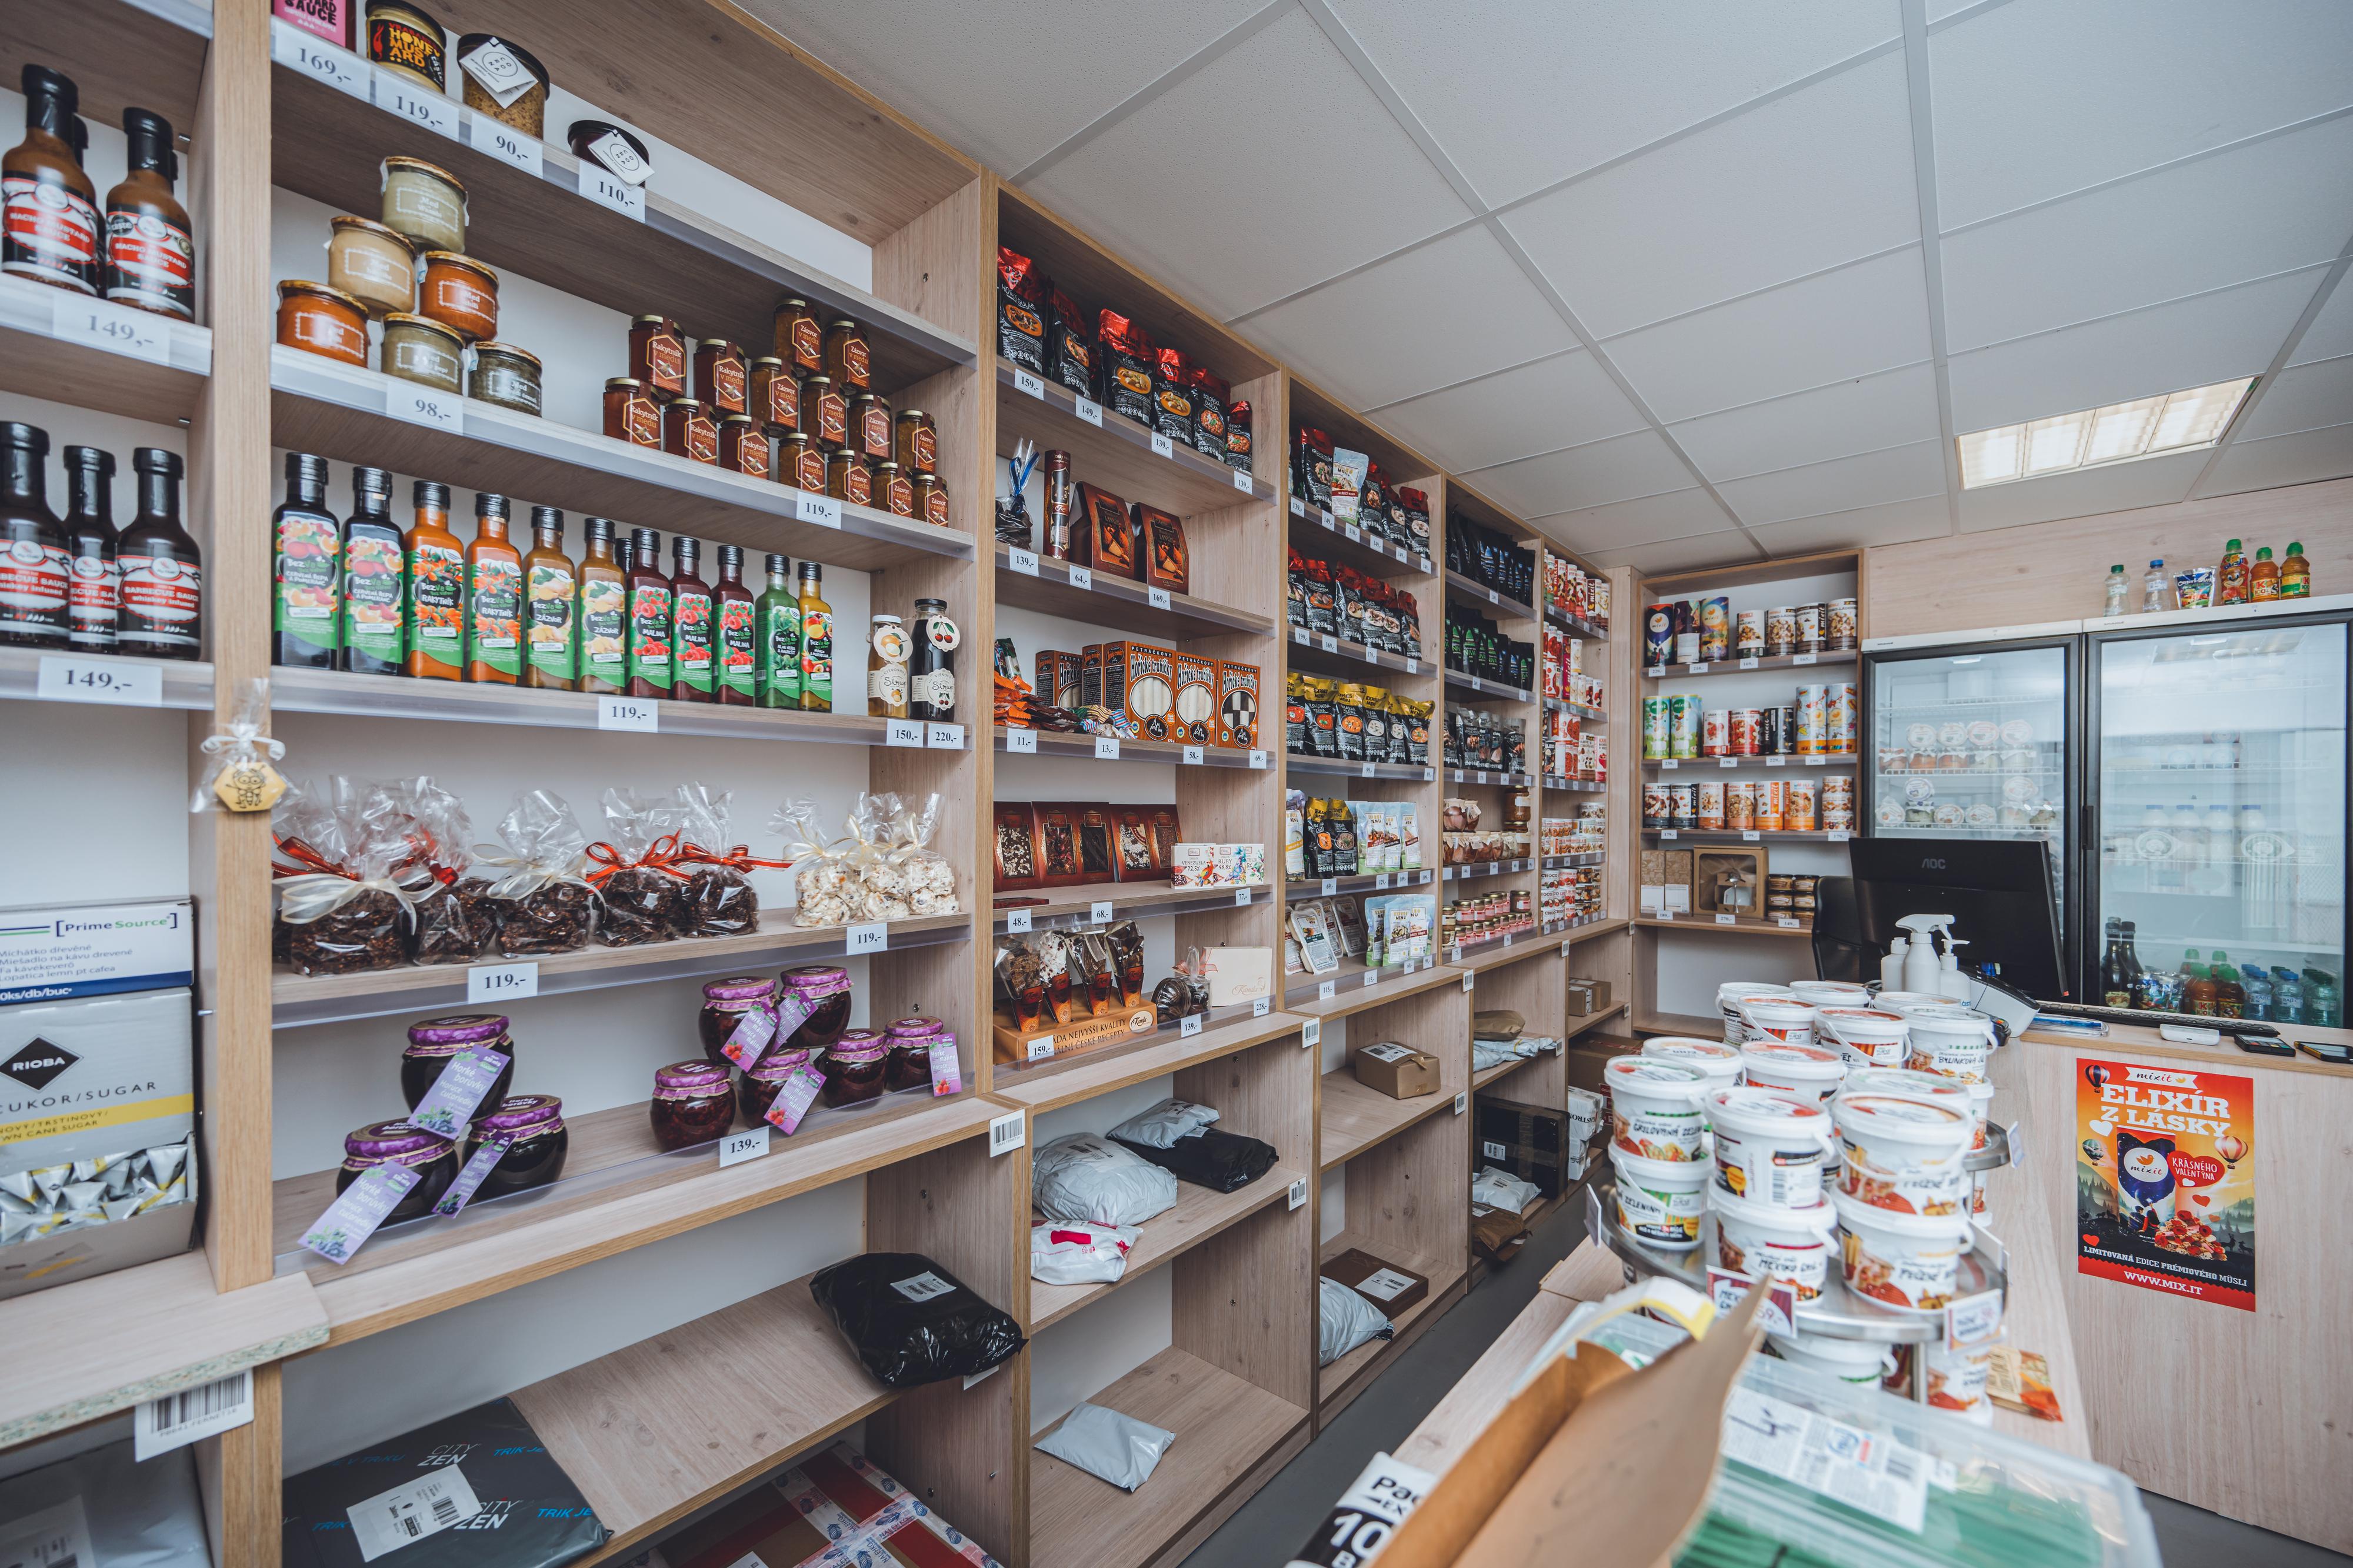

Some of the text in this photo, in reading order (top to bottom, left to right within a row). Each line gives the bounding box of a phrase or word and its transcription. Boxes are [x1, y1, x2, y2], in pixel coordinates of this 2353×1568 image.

[298, 47, 352, 82] 169,-
[396, 95, 443, 127] 119,-
[496, 135, 528, 161] 90,-
[598, 181, 635, 206] 110,-
[88, 315, 154, 348] 149,-
[801, 325, 818, 337] Zázvor
[803, 333, 819, 345] medu
[653, 341, 681, 358] Rakytník
[851, 346, 866, 357] Zázvor
[659, 352, 681, 364] medu
[853, 354, 868, 364] medu
[719, 365, 745, 379] Rakytník
[726, 375, 744, 386] medu
[1021, 376, 1039, 392] 159,-
[777, 383, 795, 395] Zázvor
[780, 392, 797, 402] medu
[415, 399, 451, 421] 98,-
[825, 401, 843, 412] Zázvor
[1081, 405, 1098, 419] 149,-
[631, 405, 658, 422] Rakytník
[828, 409, 845, 419] medu
[869, 416, 886, 426] Zázvor
[691, 423, 716, 439] Rakytník
[871, 425, 888, 433] medu
[919, 434, 934, 443] Zázvor
[1156, 438, 1169, 451] 139,-
[744, 439, 769, 453] Rakytník
[804, 458, 821, 469] Zázvor
[851, 474, 867, 483] Zázvor
[1238, 479, 1249, 490] 139,-
[894, 485, 909, 494] Zázvor
[806, 503, 832, 519] 119,-
[1016, 555, 1034, 568] 139,-
[1075, 574, 1088, 584] 64,-
[125, 586, 175, 599] BARBECUE
[1152, 593, 1167, 604] 169,-
[65, 669, 132, 693] 149,-
[612, 706, 646, 722] 119,-
[896, 729, 918, 741] 150,-
[935, 732, 957, 743] 220,-
[1017, 736, 1031, 748] 11,-
[1102, 745, 1114, 753] 13,-
[1921, 858, 1946, 869] AOC
[1096, 910, 1108, 919] 68,-
[1012, 917, 1026, 928] 48,-
[856, 932, 882, 945] 119,-
[484, 974, 526, 990] 119,-
[1257, 1003, 1267, 1011] 228,-
[1068, 1018, 1126, 1040] NEJVYŠŠÍ KVALITY
[1185, 1022, 1198, 1031] 139,-
[1098, 1029, 1125, 1043] RECEPTY
[1034, 1045, 1051, 1056] 159,-
[12, 1057, 66, 1072] RIOBA
[2137, 1072, 2173, 1083] mixit
[2101, 1083, 2231, 1119] ELIXÍR
[2101, 1105, 2231, 1137] Z LÁSKY
[730, 1139, 761, 1153] 139,-
[2130, 1165, 2163, 1175] mixit
[2172, 1157, 2218, 1173] KRÁSNÉHO
[2175, 1167, 2215, 1181] VALENTÝNA
[2084, 1245, 2248, 1287] LIMITOVANÁ EDICE PRÉMIOVÉHO MÜSLI
[2124, 1270, 2203, 1295] WWW.MIX.IT
[432, 1443, 478, 1455] CITY
[493, 1446, 524, 1457] TRIK
[418, 1453, 467, 1466] ZEN
[538, 1507, 594, 1519] TRIK JE
[454, 1514, 509, 1530] ZEN
